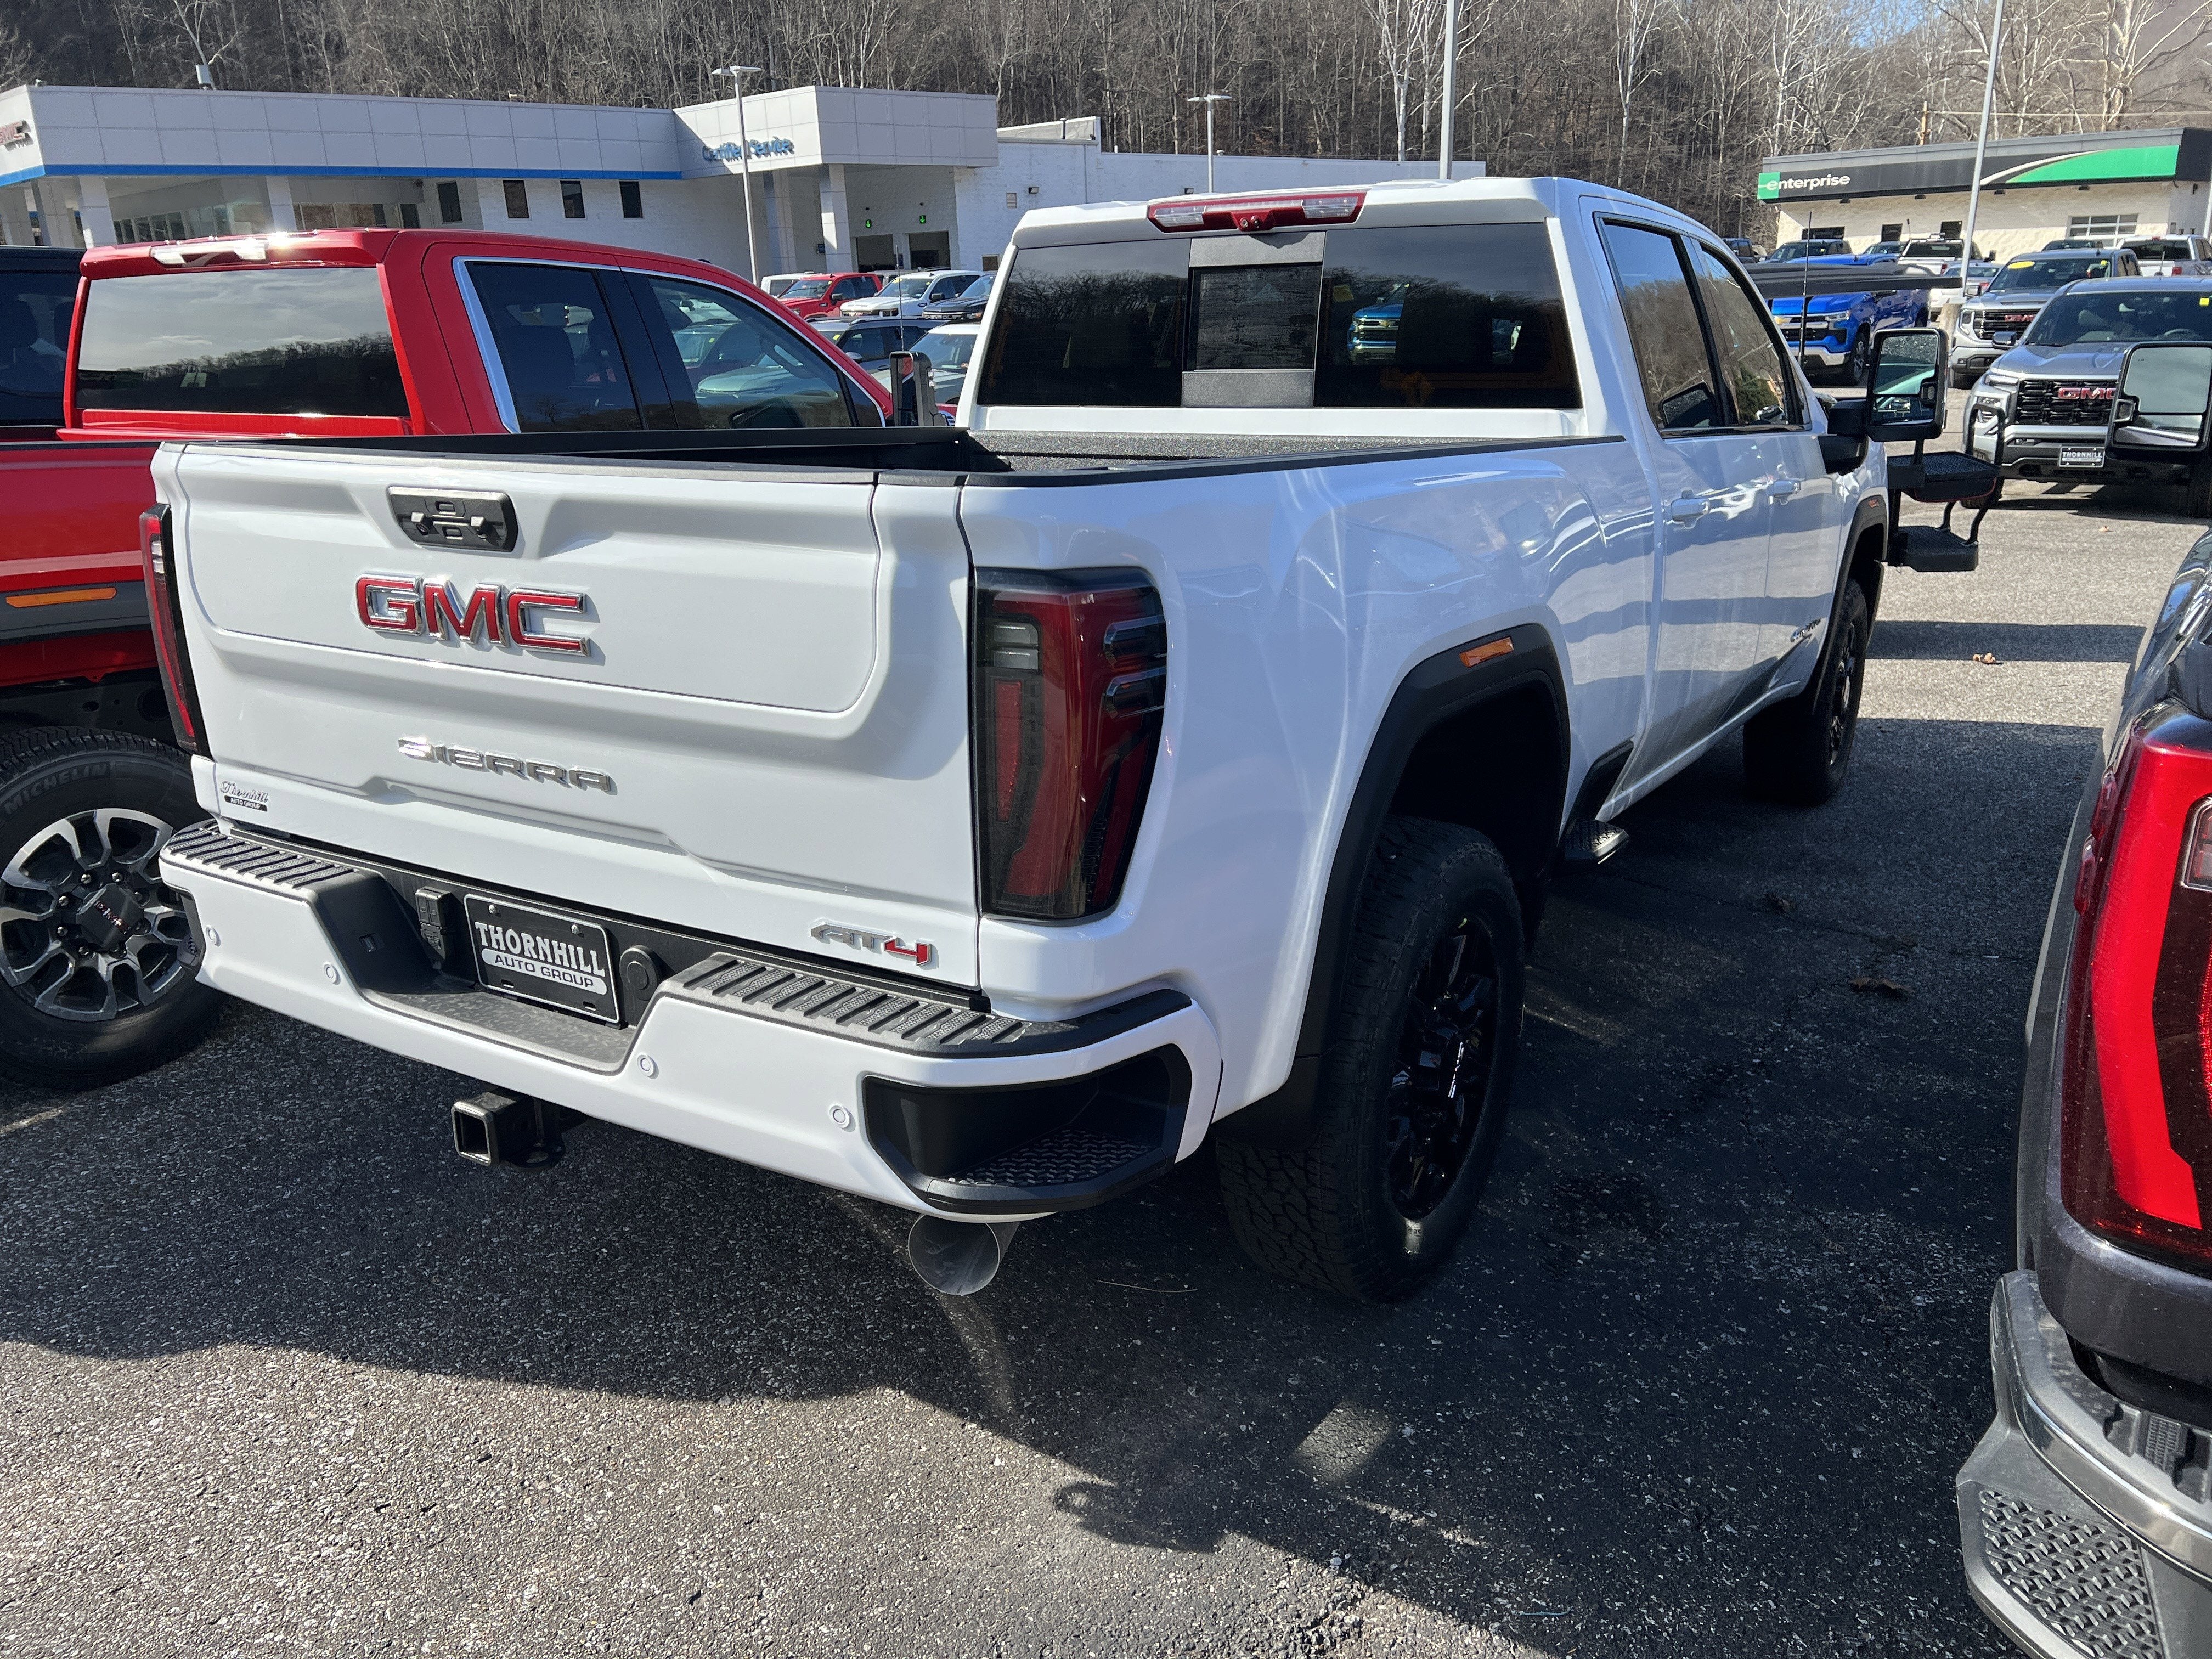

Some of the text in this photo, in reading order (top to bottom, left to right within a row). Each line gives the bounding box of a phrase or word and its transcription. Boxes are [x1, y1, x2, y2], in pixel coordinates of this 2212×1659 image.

[703, 138, 792, 161] Certifie Service
[1766, 174, 1850, 190] enterprise
[356, 572, 591, 657] GMC
[398, 736, 611, 793] SIERRA
[4, 761, 109, 816] MICHELIN
[230, 797, 261, 809] AUTO GROUP
[475, 922, 606, 977] THORNHILL
[810, 922, 932, 966] AT4
[494, 955, 594, 988] AUTO GROUP
